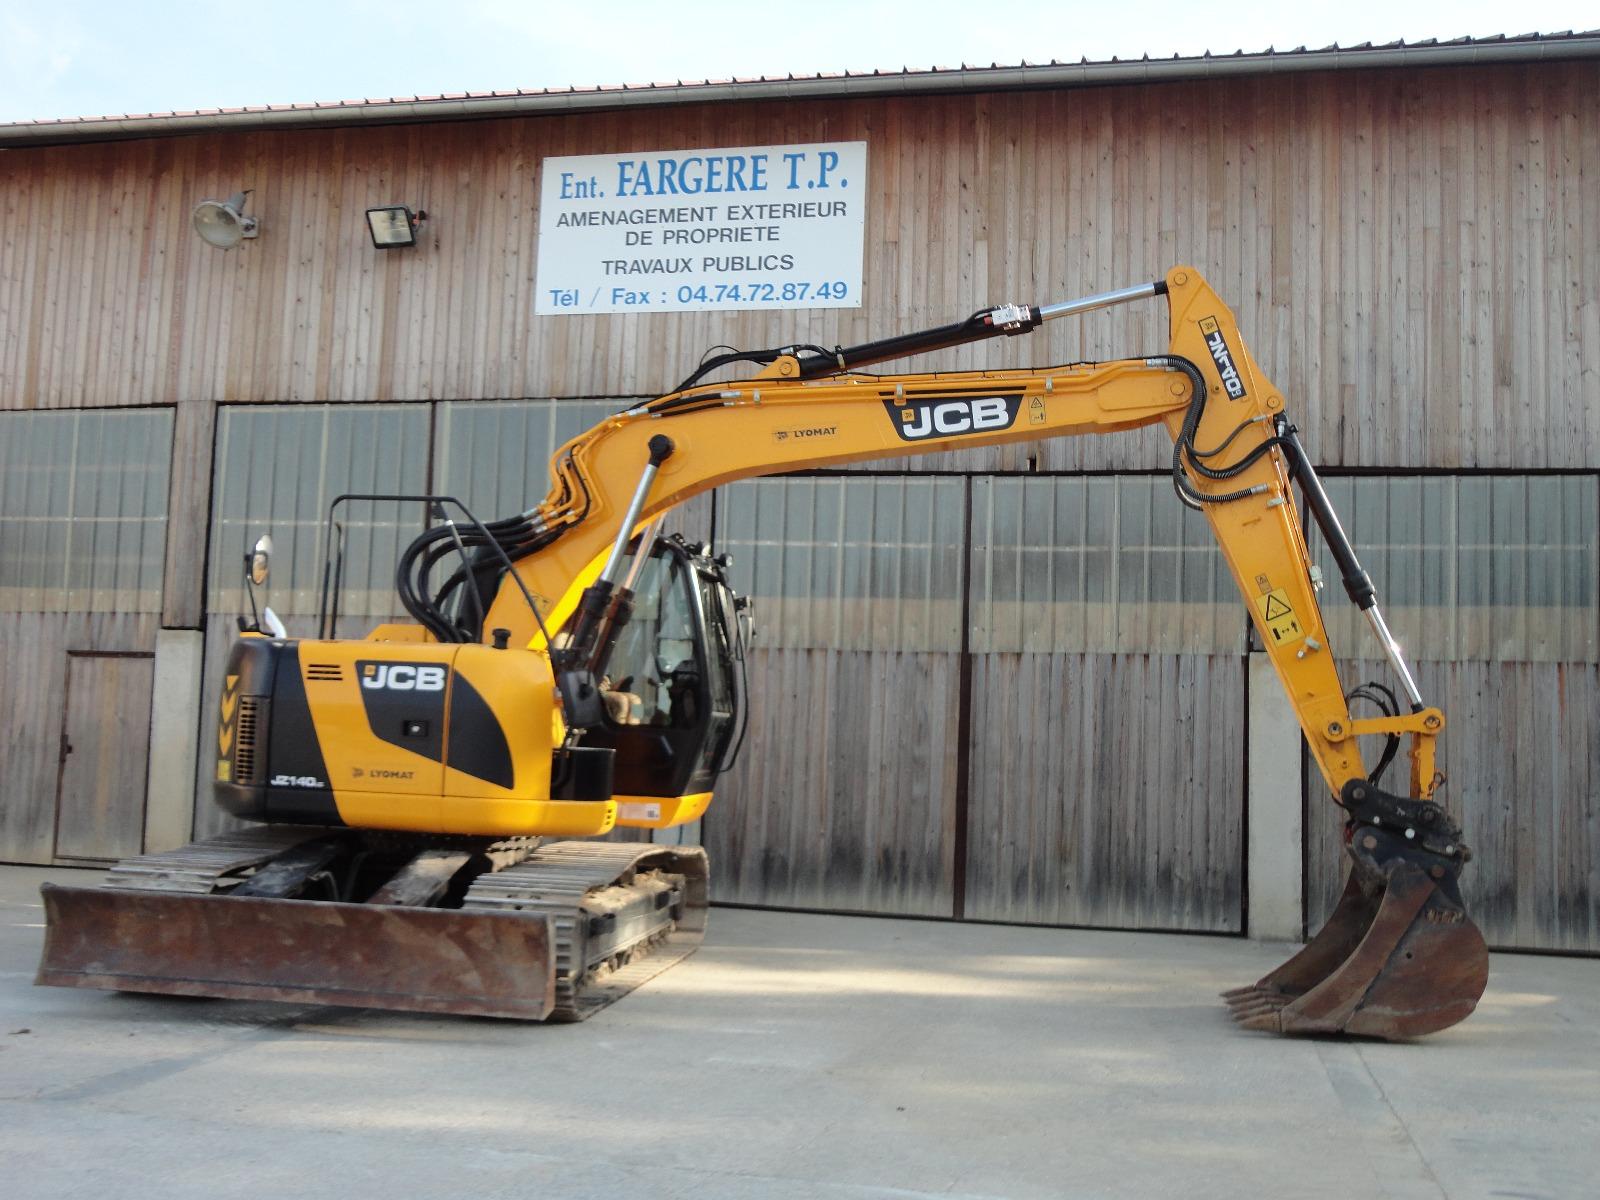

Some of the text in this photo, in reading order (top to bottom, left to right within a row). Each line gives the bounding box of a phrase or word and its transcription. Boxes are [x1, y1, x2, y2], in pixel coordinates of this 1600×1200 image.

[559, 150, 849, 199] Ent. FARGERE T.P.
[556, 201, 847, 228] AMENAGEMENT EXTERIEUR
[625, 226, 780, 246] DE PROPRIETE
[602, 254, 794, 275] TRAVAUX PUBLICS
[550, 288, 579, 307] Tél
[611, 287, 651, 305] Fax
[677, 281, 848, 304] 04.74.72.87.49
[902, 397, 1009, 438] JCB
[793, 427, 837, 438] LYOMAT
[362, 665, 446, 691] JCB
[370, 770, 414, 779] LYOMAT
